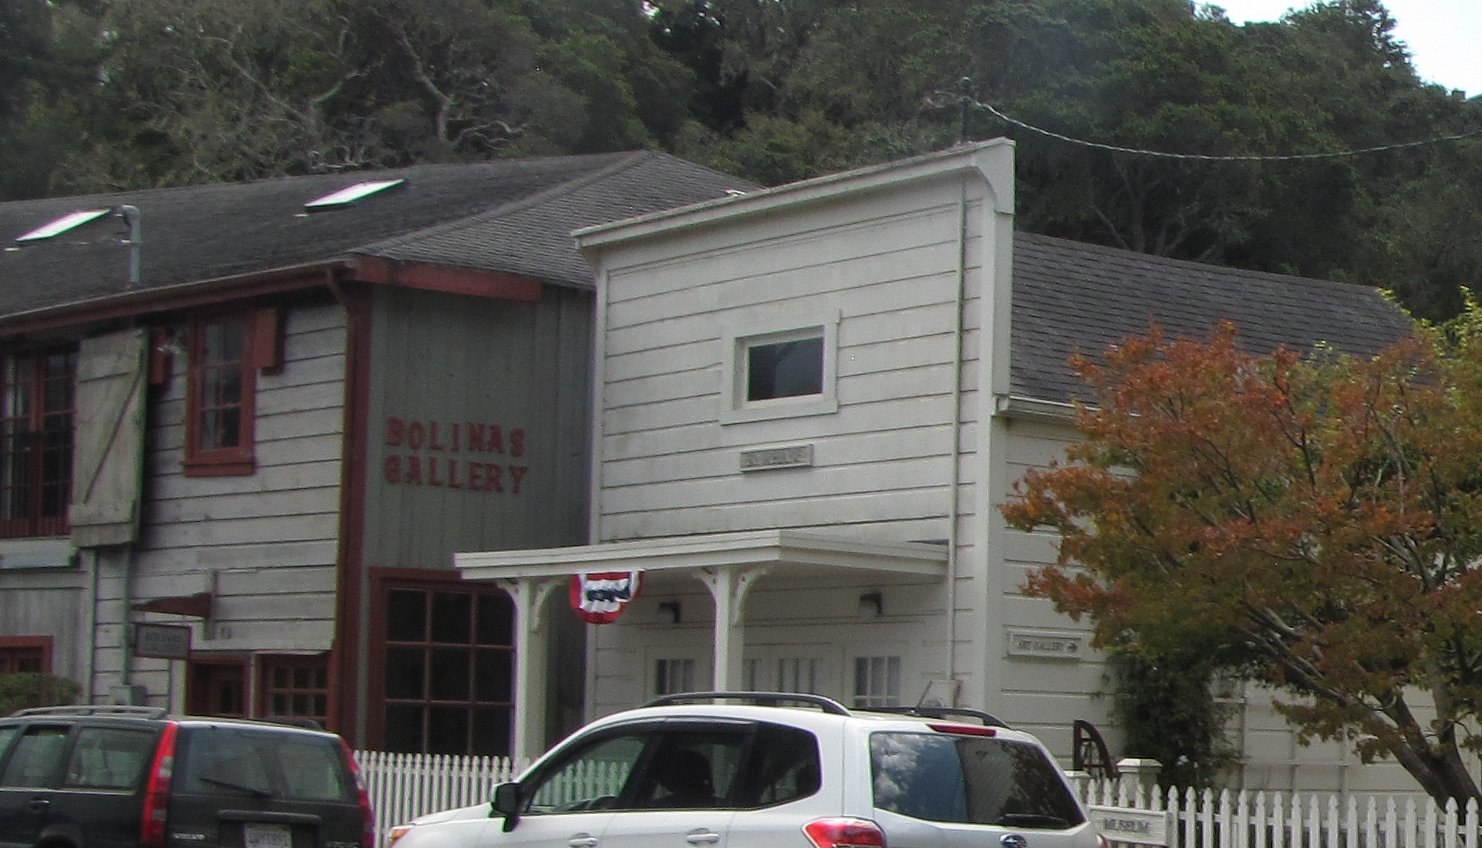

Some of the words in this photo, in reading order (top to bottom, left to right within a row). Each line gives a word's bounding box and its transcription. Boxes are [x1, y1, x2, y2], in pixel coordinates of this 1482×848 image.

[385, 416, 525, 457] BOLINAS
[384, 454, 528, 495] GALLERY
[1104, 818, 1151, 834] MUSEUM
